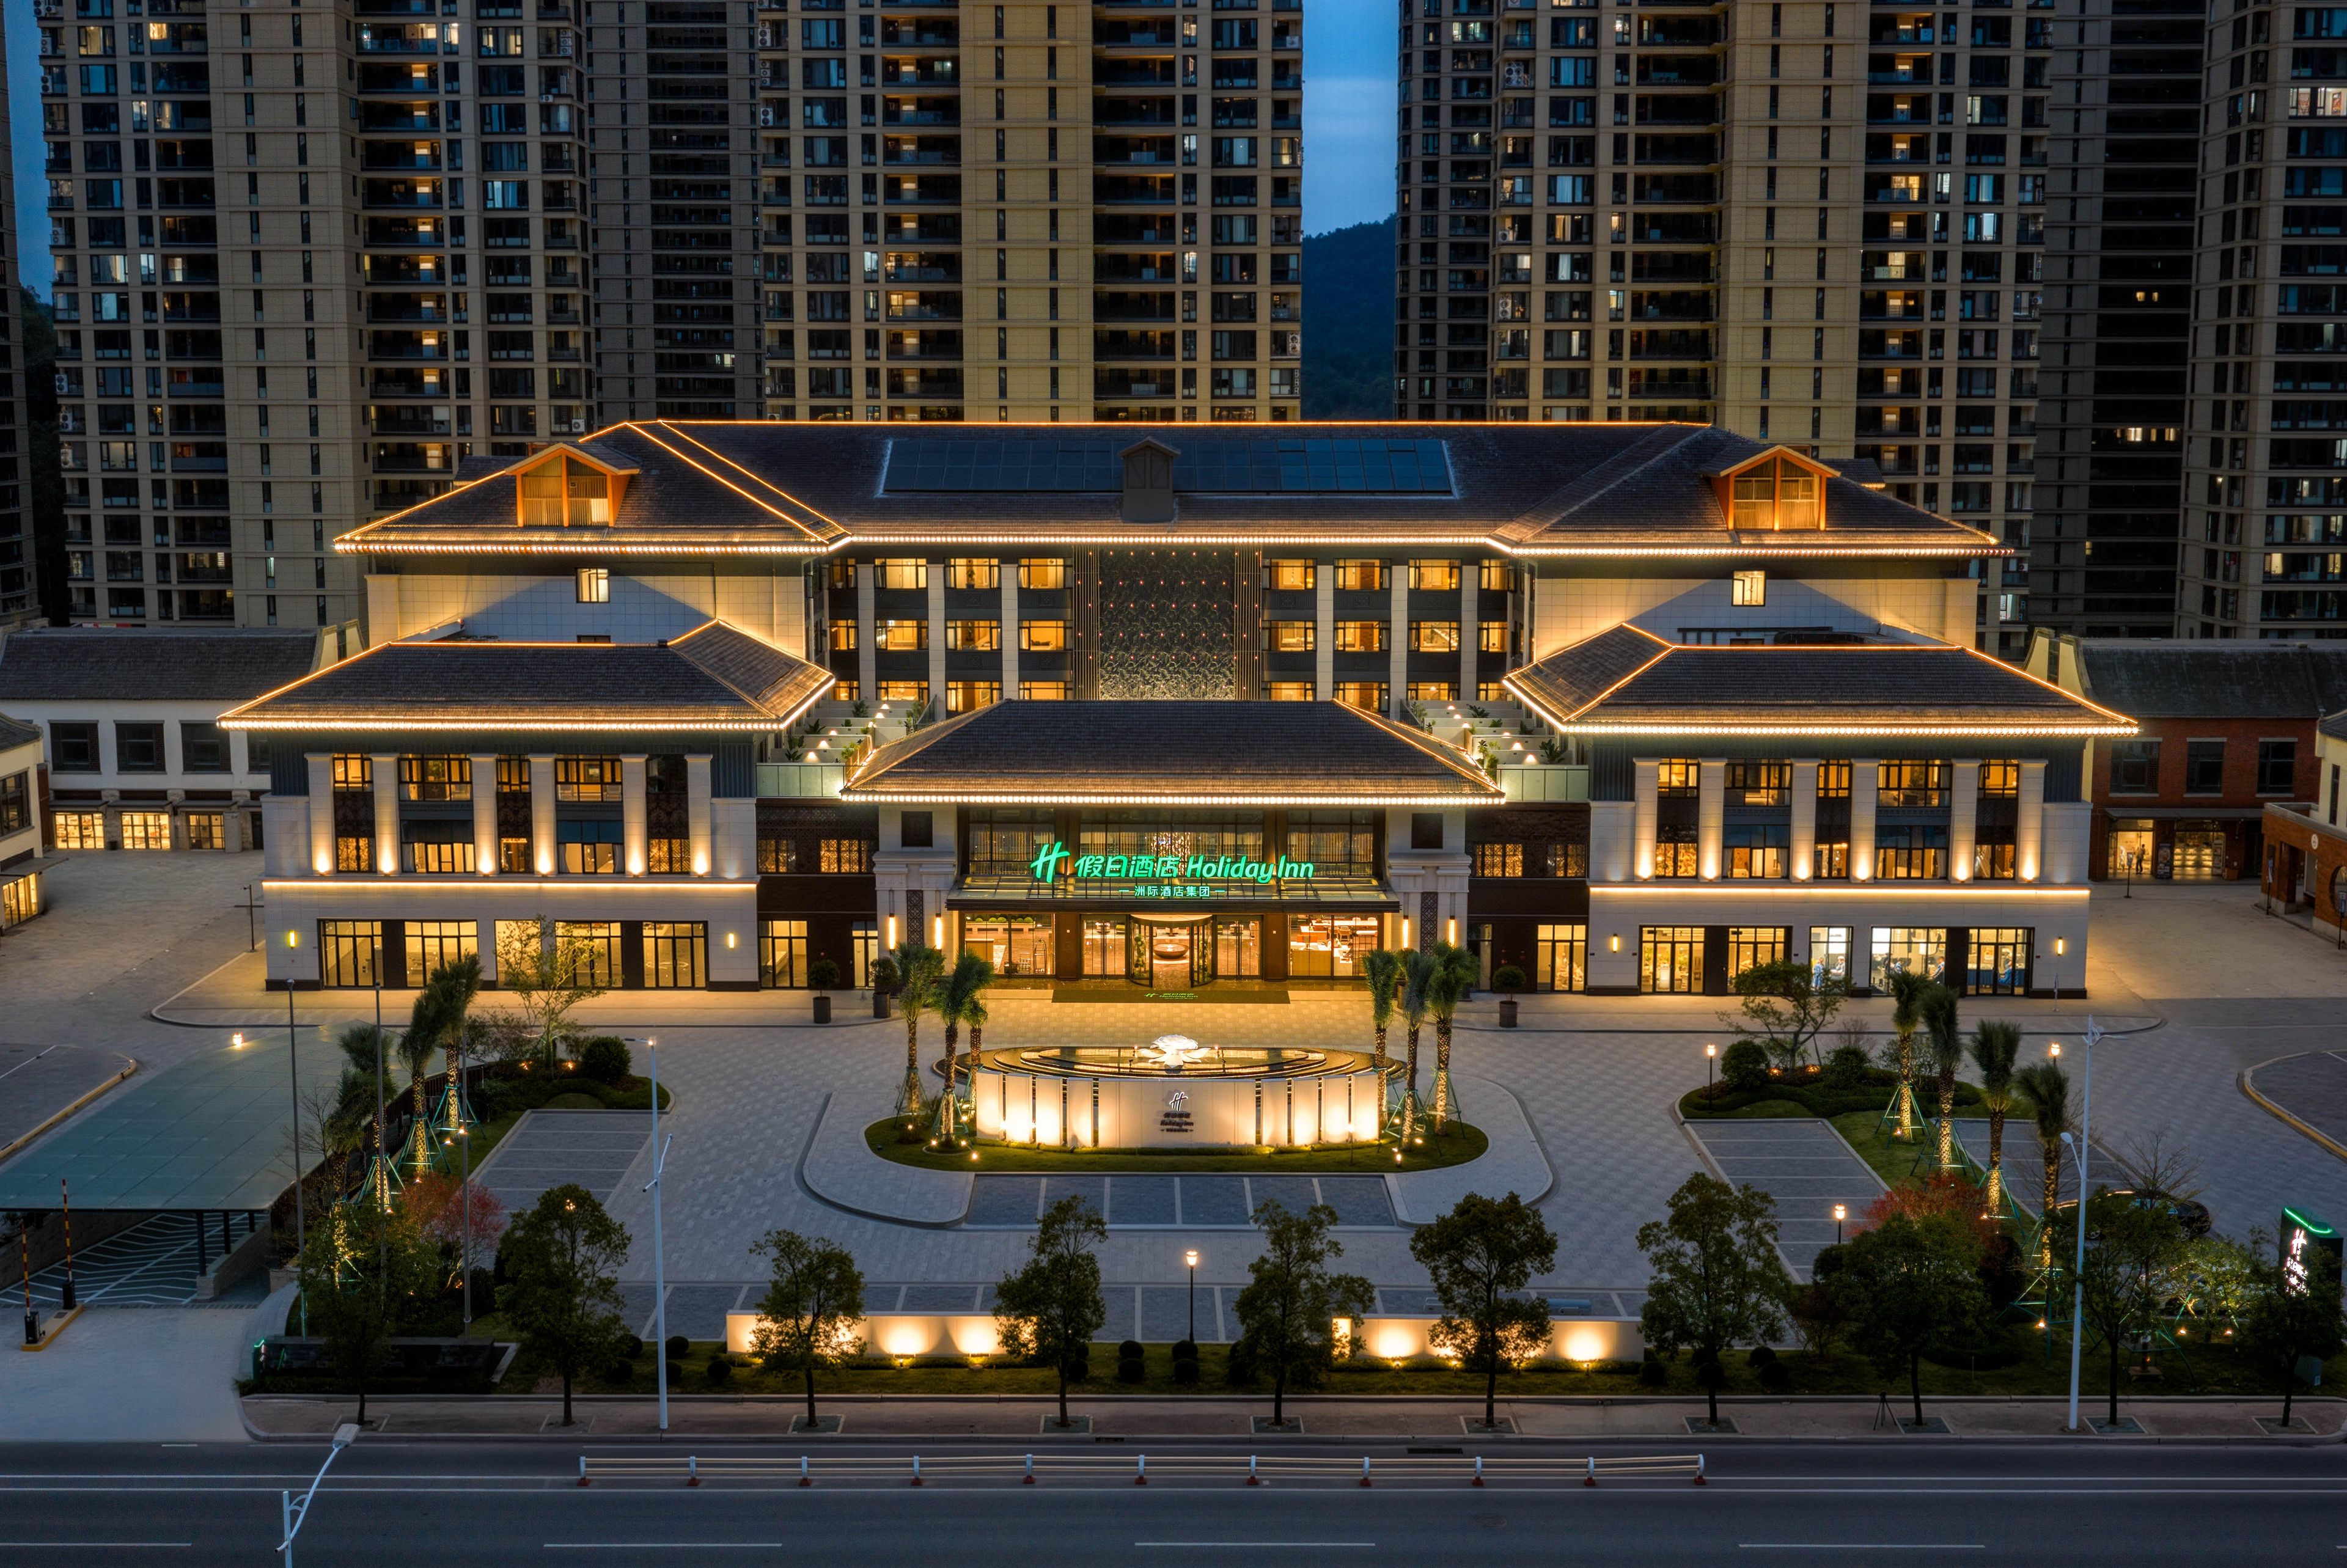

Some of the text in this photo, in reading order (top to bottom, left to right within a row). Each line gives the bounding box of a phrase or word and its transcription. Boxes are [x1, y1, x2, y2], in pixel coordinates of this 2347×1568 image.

[1074, 855, 1181, 878] 假日酒店
[1186, 854, 1314, 884] Holiday Inn
[1134, 885, 1210, 898] 洲际酒店集团
